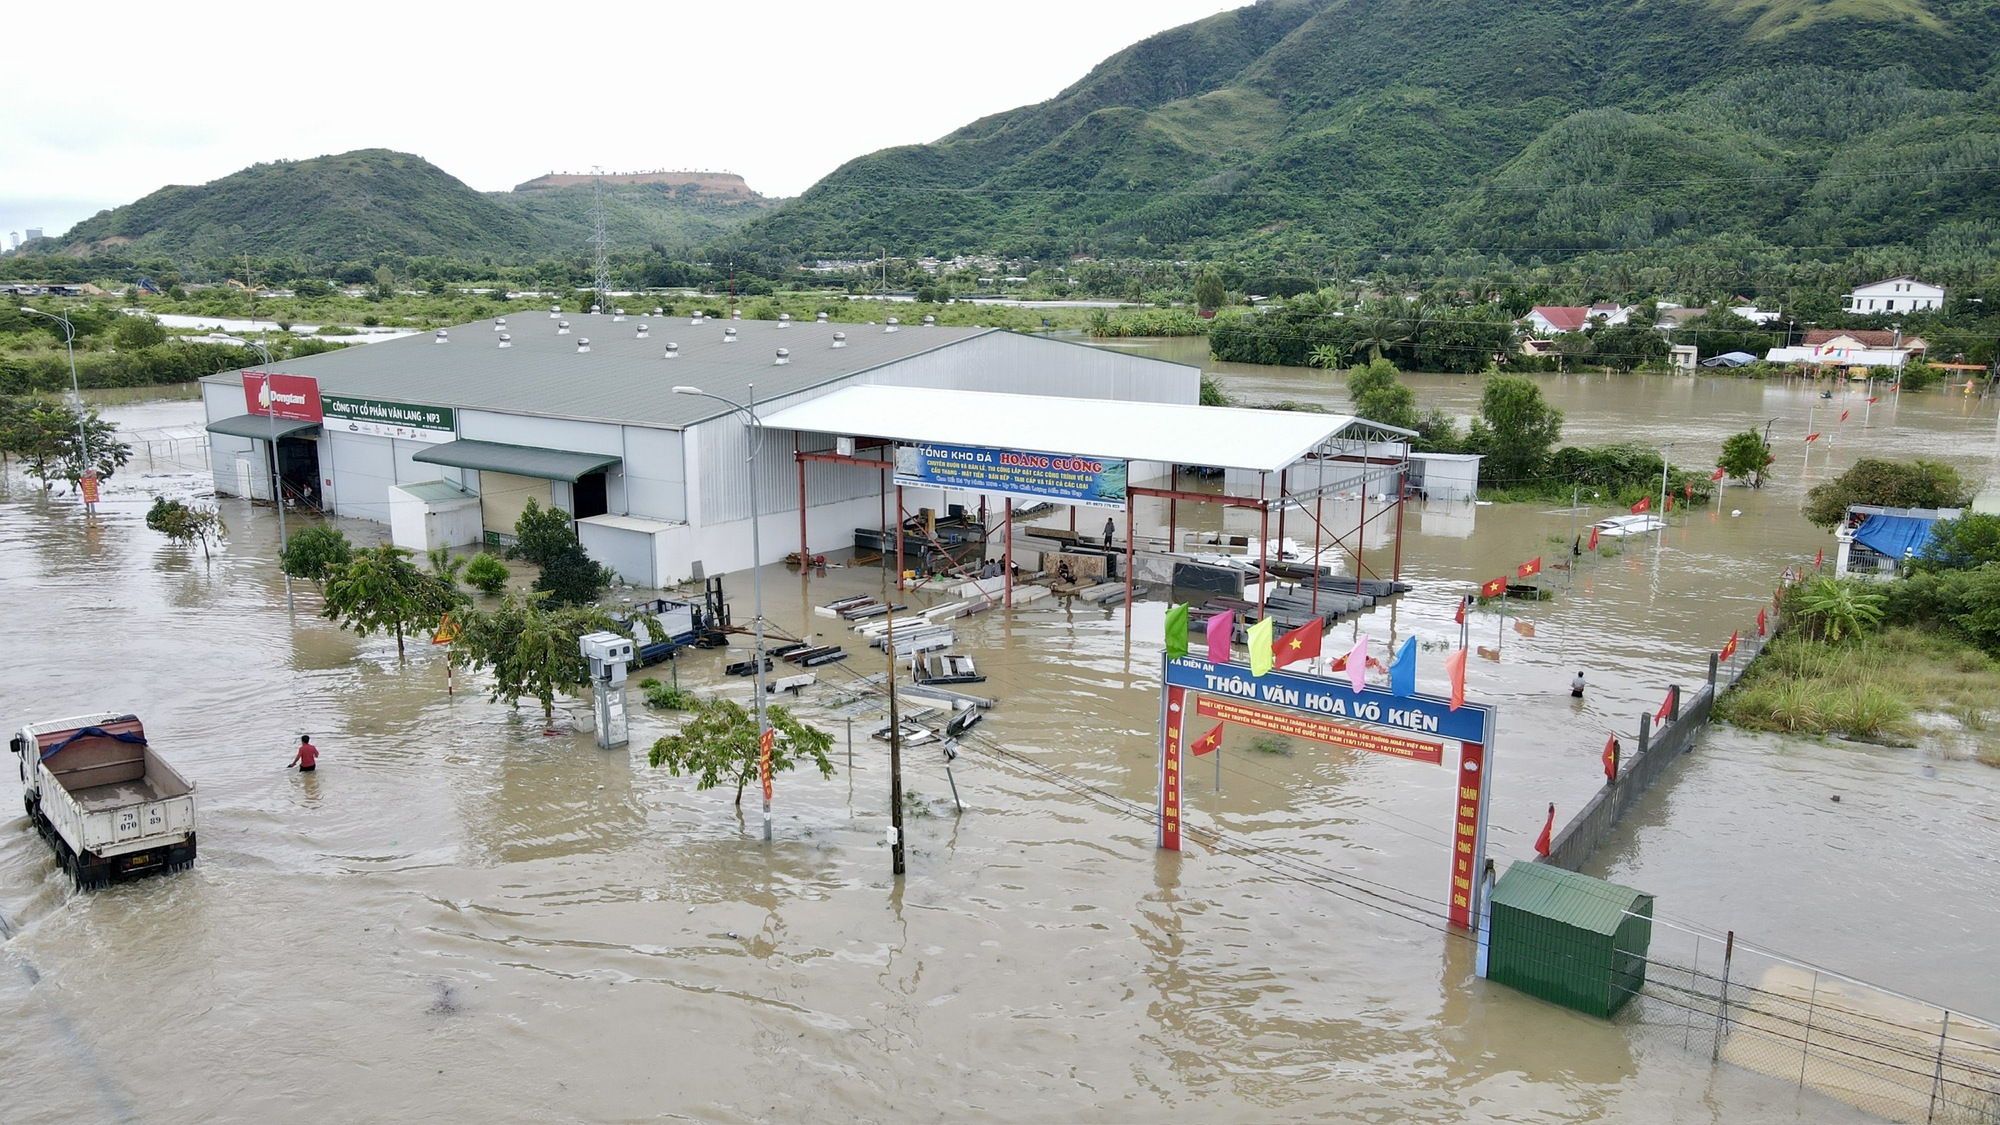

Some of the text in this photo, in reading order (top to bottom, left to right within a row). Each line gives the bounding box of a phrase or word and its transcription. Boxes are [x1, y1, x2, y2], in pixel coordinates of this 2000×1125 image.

[332, 400, 350, 413] CÔNG
[350, 404, 358, 414] TY
[360, 401, 369, 416] CỔ
[370, 404, 387, 418] PHẦN
[388, 407, 402, 419] VĂN
[403, 410, 421, 421] LANG
[426, 413, 440, 424] NP3
[920, 445, 1102, 473] TỔNG KHO ĐÁ HOÀNG CƯỜNG
[1202, 663, 1214, 672] AN
[1204, 674, 1257, 697] THÔN
[1262, 685, 1299, 706] VĂN
[1353, 702, 1380, 720] VÕ
[1388, 708, 1439, 732] KIỆN
[121, 817, 161, 832] 070 89
